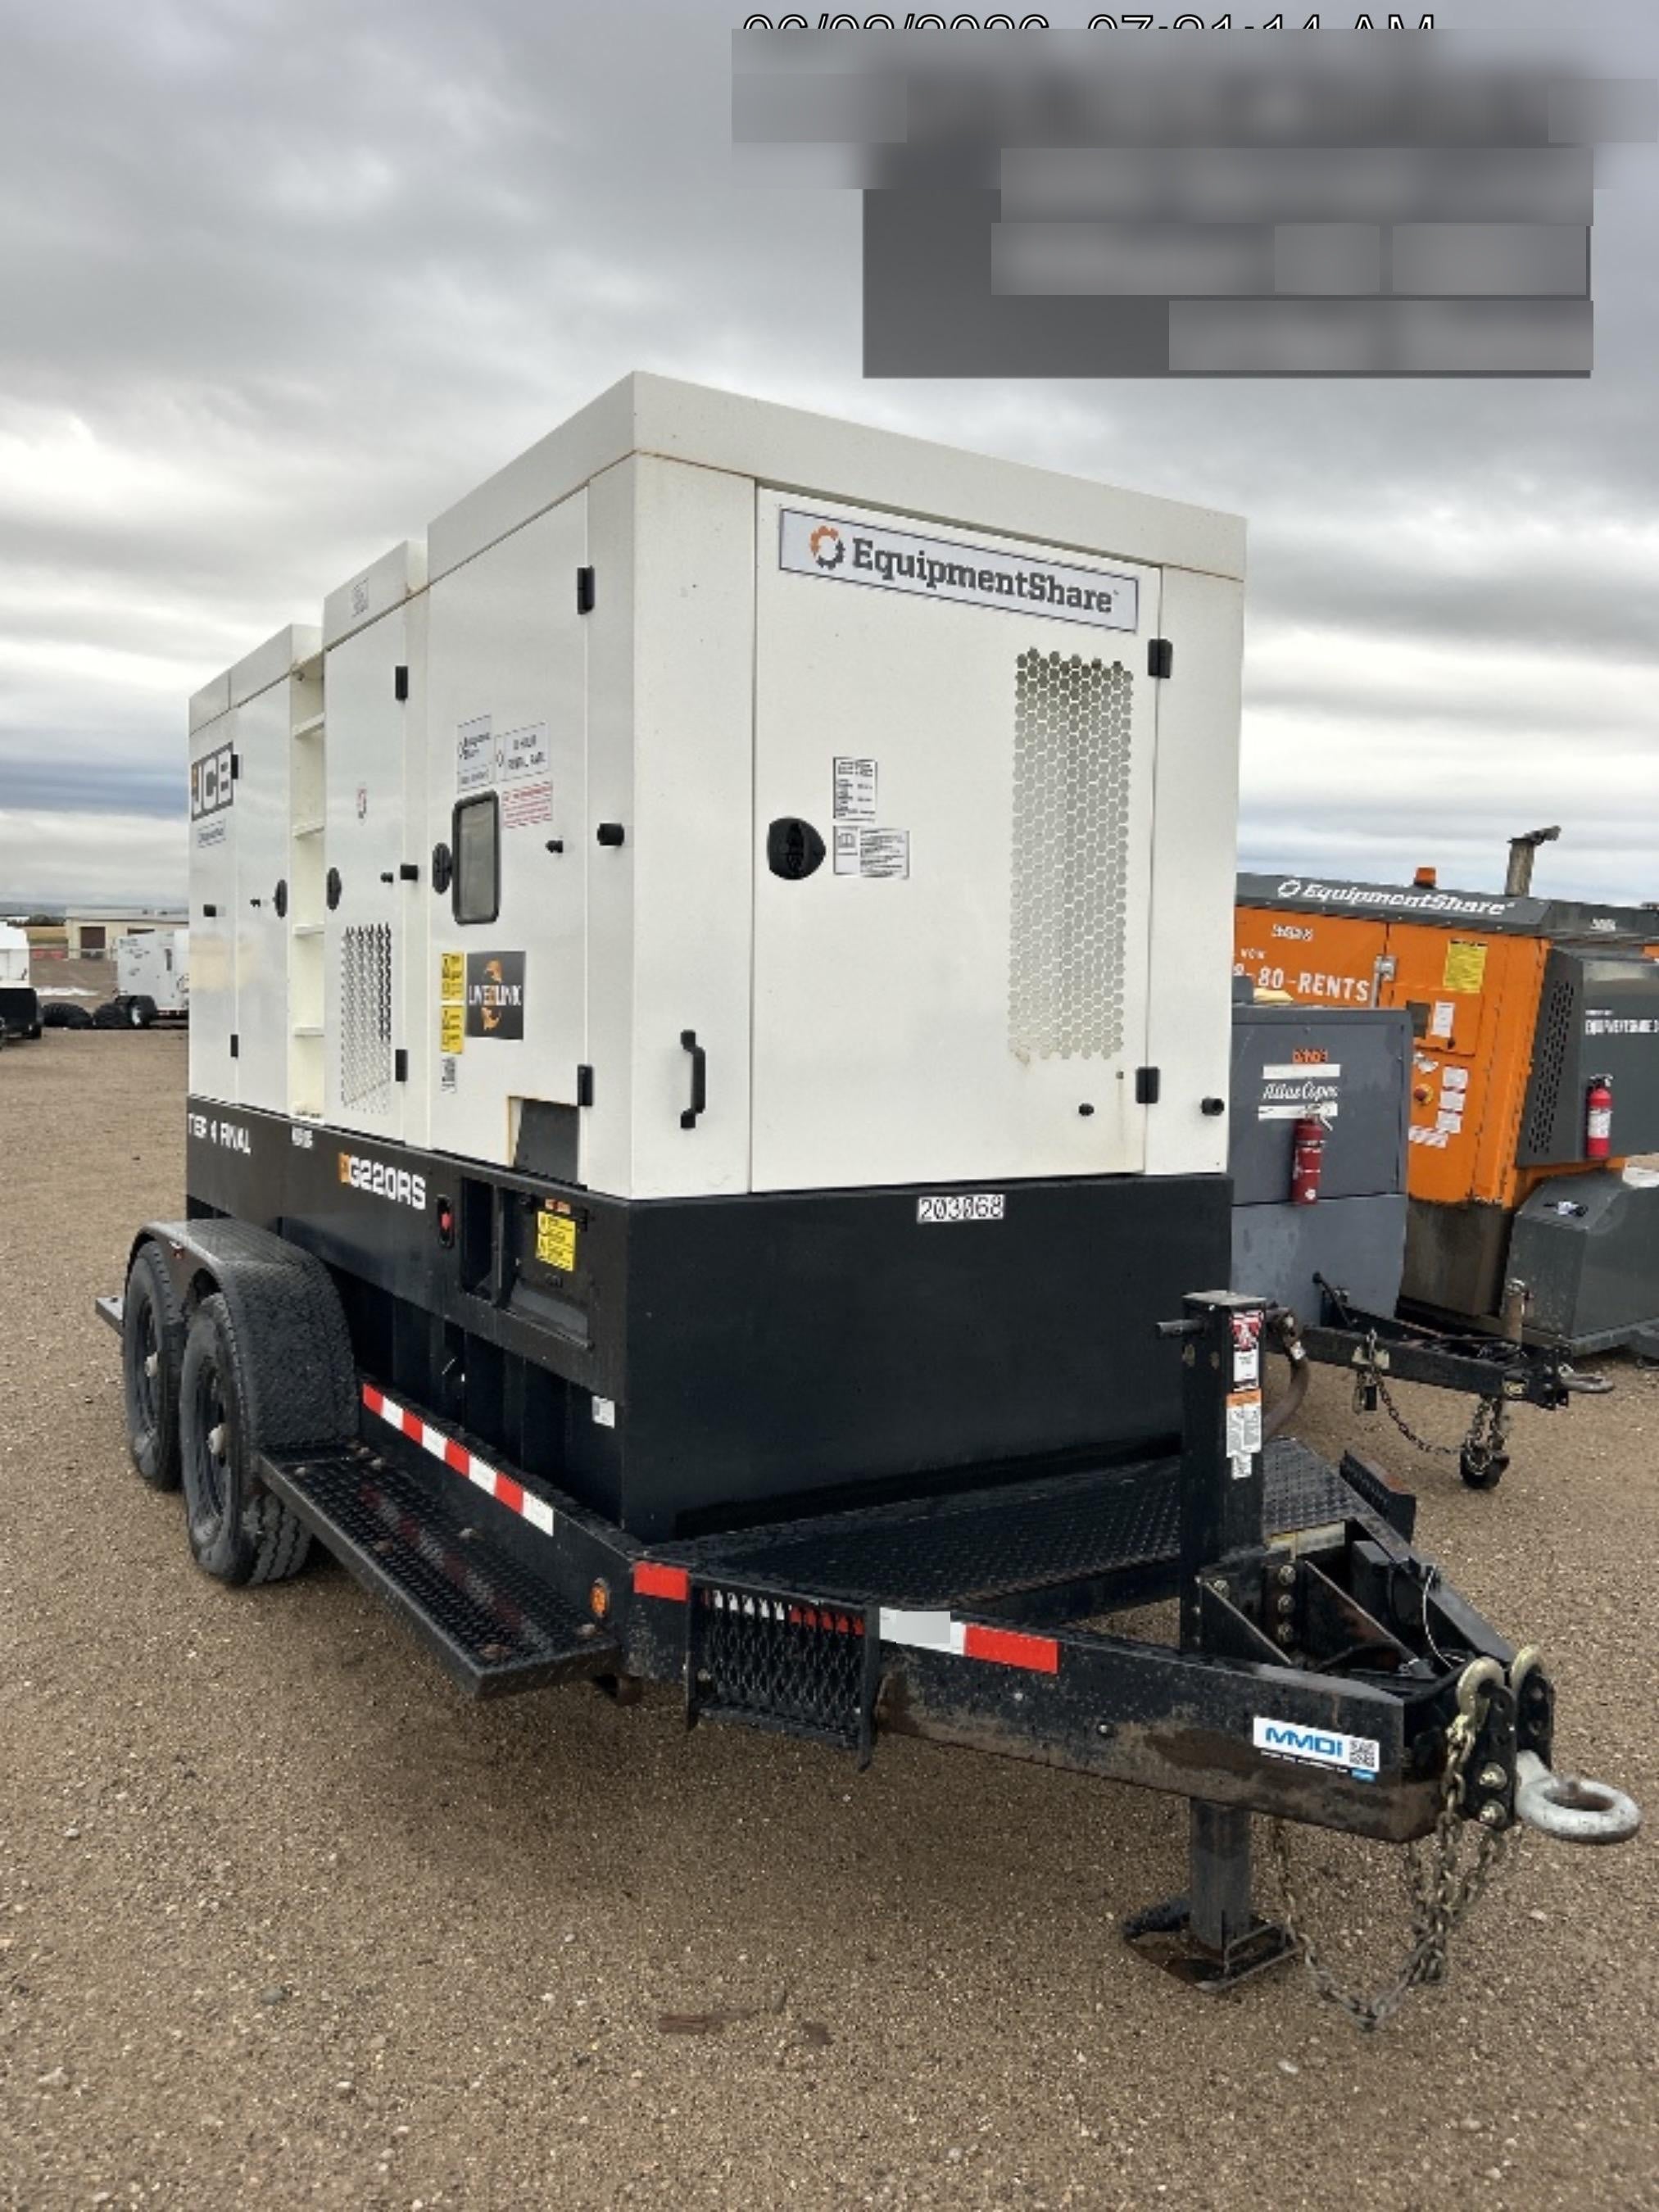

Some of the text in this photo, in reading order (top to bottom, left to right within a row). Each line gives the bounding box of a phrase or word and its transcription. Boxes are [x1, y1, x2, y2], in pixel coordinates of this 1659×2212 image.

[852, 537, 1113, 614] EquipmentShare
[1301, 882, 1507, 916] EquipmentShare
[348, 1155, 427, 1210] G220RS
